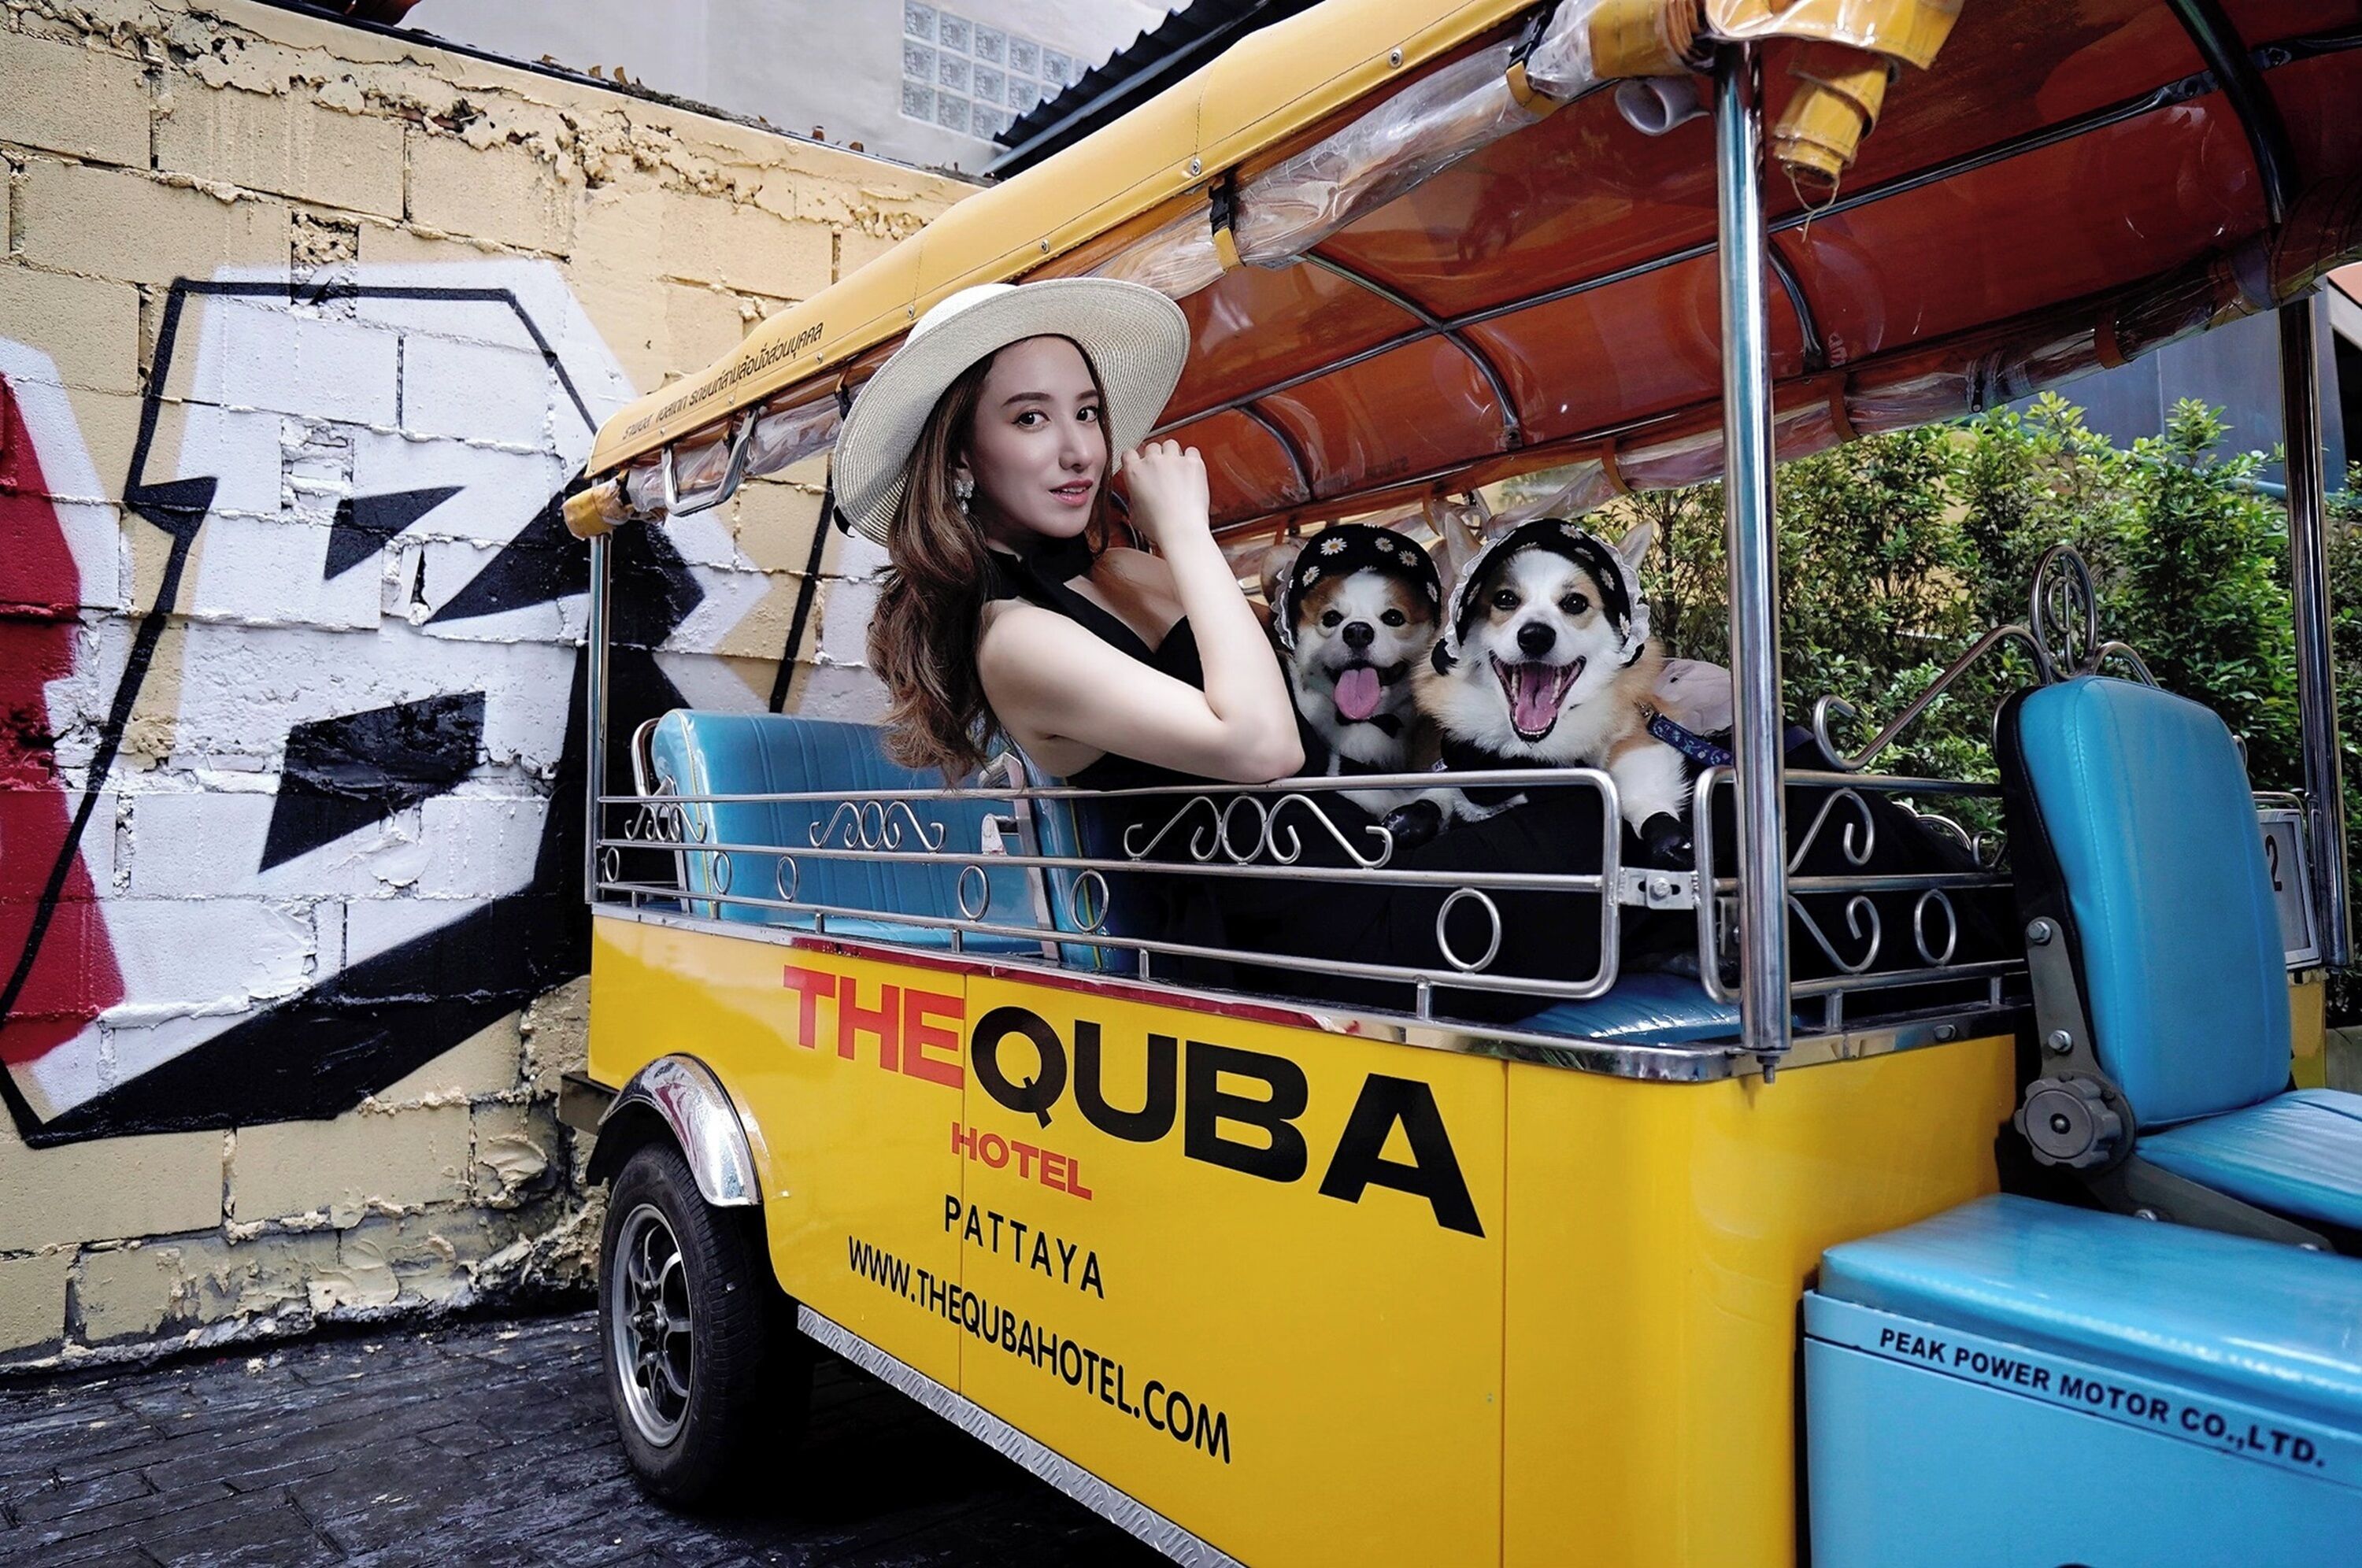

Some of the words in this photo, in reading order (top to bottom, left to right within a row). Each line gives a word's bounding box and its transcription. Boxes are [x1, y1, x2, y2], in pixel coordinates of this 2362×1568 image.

[783, 964, 963, 1089] THE
[971, 1006, 1486, 1238] QUBA
[951, 1122, 1093, 1200] HOTEL
[945, 1194, 1104, 1300] PATTAYA
[847, 1236, 1231, 1463] WWW.THEQUBAHOTEL.COM
[1879, 1328, 1946, 1363] PEAK
[1953, 1347, 2049, 1392] POWER
[2058, 1374, 2170, 1423] MOTOR
